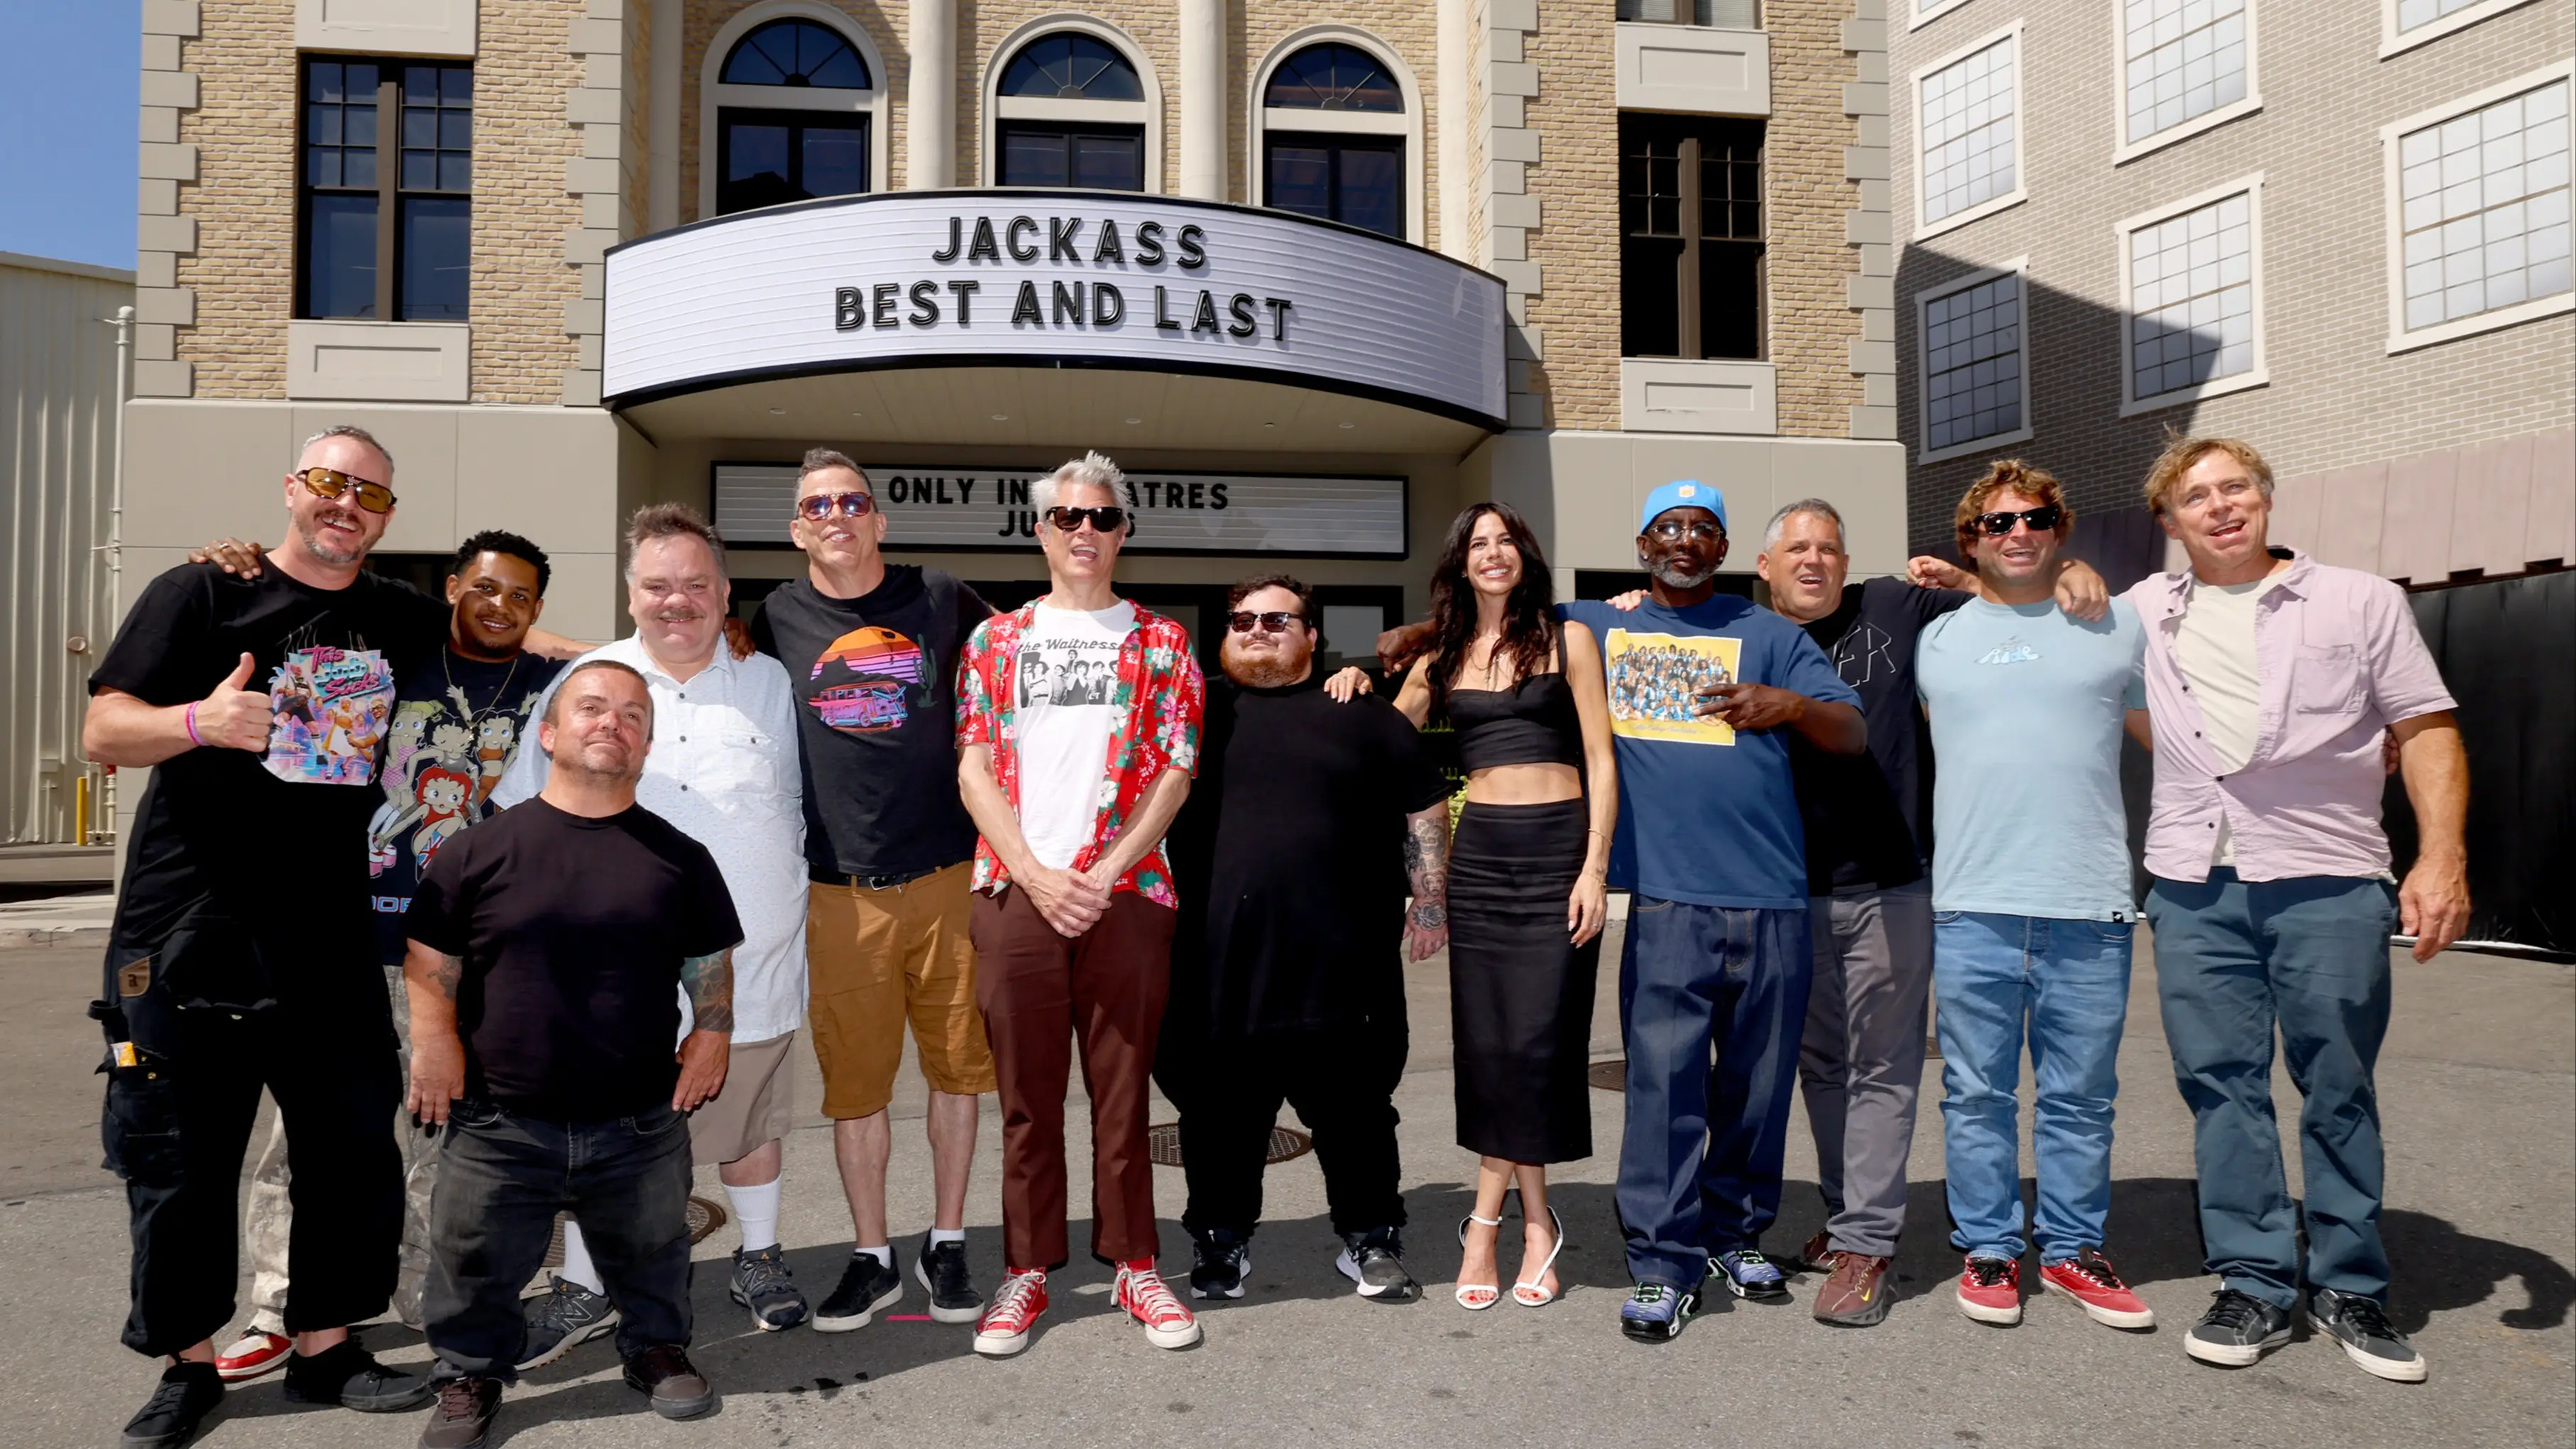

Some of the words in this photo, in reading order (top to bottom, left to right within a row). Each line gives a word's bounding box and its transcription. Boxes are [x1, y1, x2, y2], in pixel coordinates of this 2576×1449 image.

[932, 215, 1205, 268] JACKASS
[835, 280, 978, 330] BEST
[1011, 280, 1124, 325] AND
[1155, 285, 1292, 341] LAST
[888, 476, 975, 504] ONLY
[997, 478, 1029, 505] IN
[1126, 481, 1229, 510] ATRES
[998, 510, 1038, 537] JU
[301, 644, 345, 673] This
[1046, 638, 1119, 650] Waitress
[323, 674, 379, 701] Sucks
